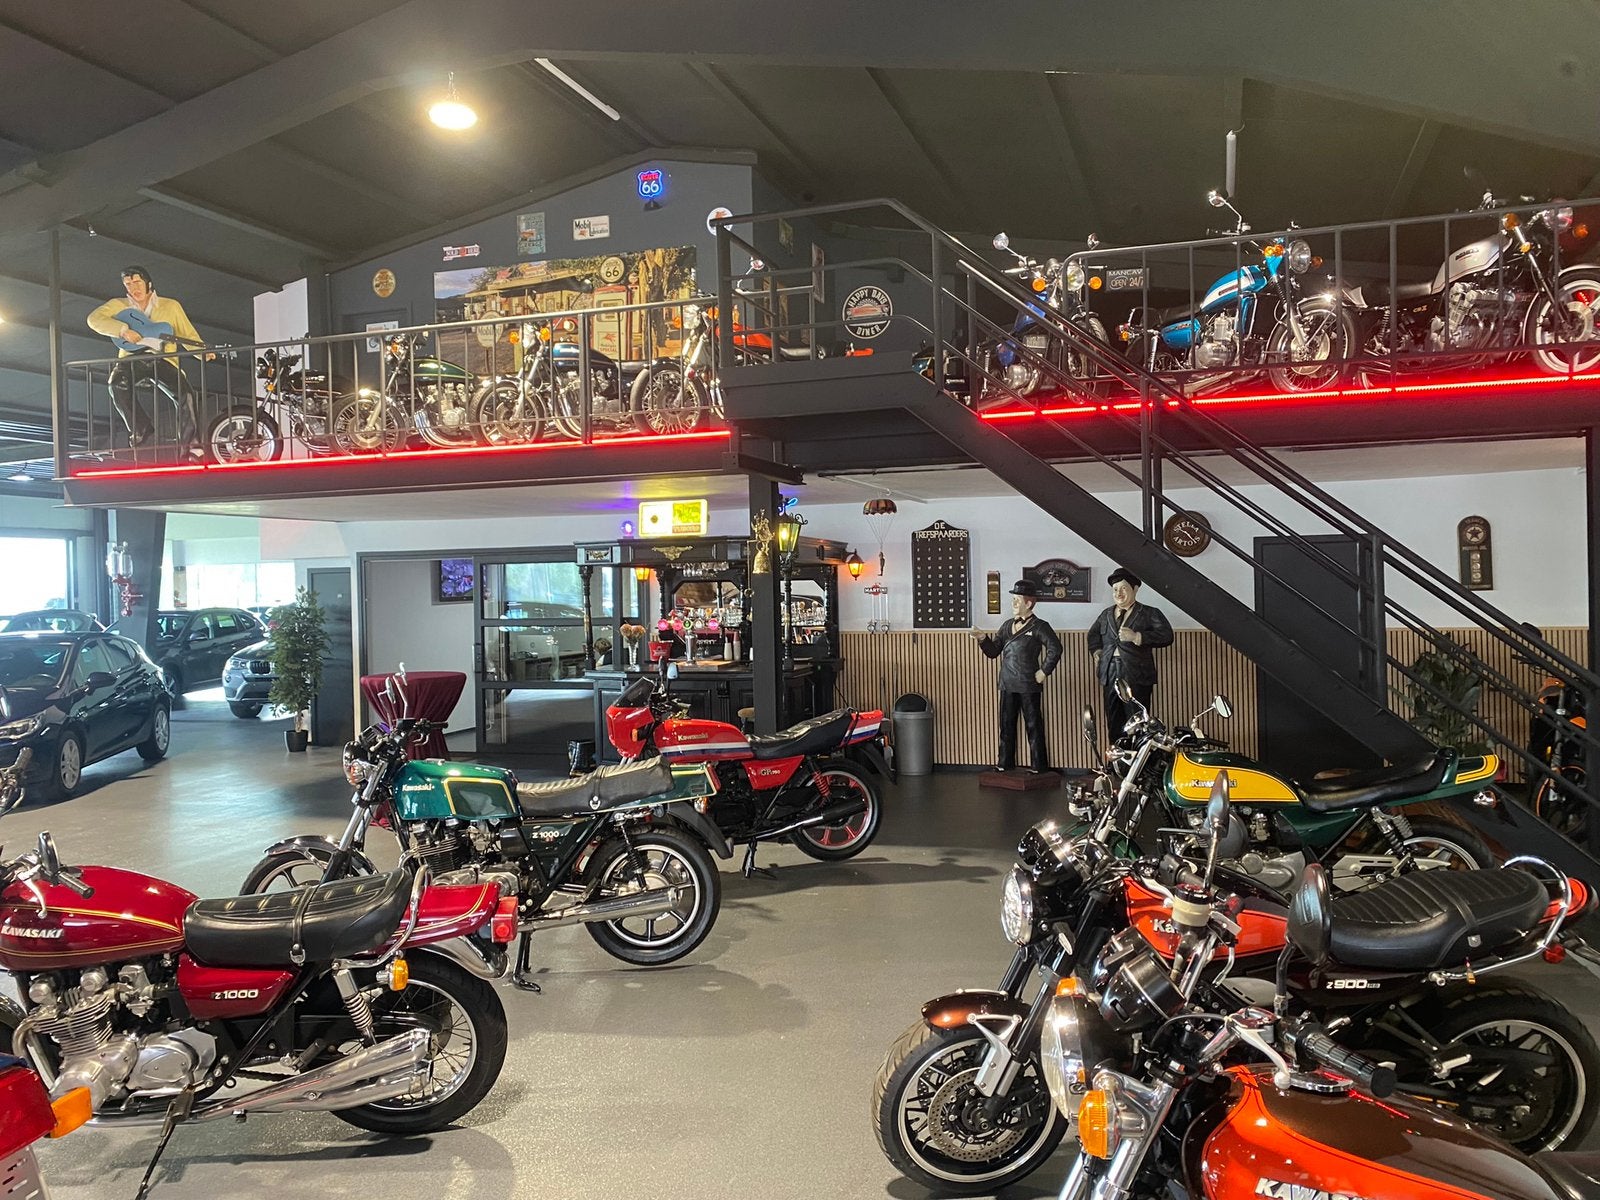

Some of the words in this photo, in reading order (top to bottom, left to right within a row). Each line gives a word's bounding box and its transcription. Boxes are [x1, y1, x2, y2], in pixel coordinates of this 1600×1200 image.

[641, 180, 660, 194] 66
[605, 266, 620, 278] 66
[1110, 278, 1127, 288] OPEN
[847, 289, 869, 308] HAPPY
[871, 289, 888, 305] DAYS
[856, 324, 881, 336] DINER
[934, 522, 946, 530] DE
[1173, 521, 1200, 533] STELLA
[914, 530, 968, 539] TREFSPAARDERS
[1173, 535, 1201, 547] ARTOIS
[677, 733, 709, 742] Kawasaki
[401, 783, 432, 792] Kawasaki
[1, 925, 64, 939] KAWASAKI
